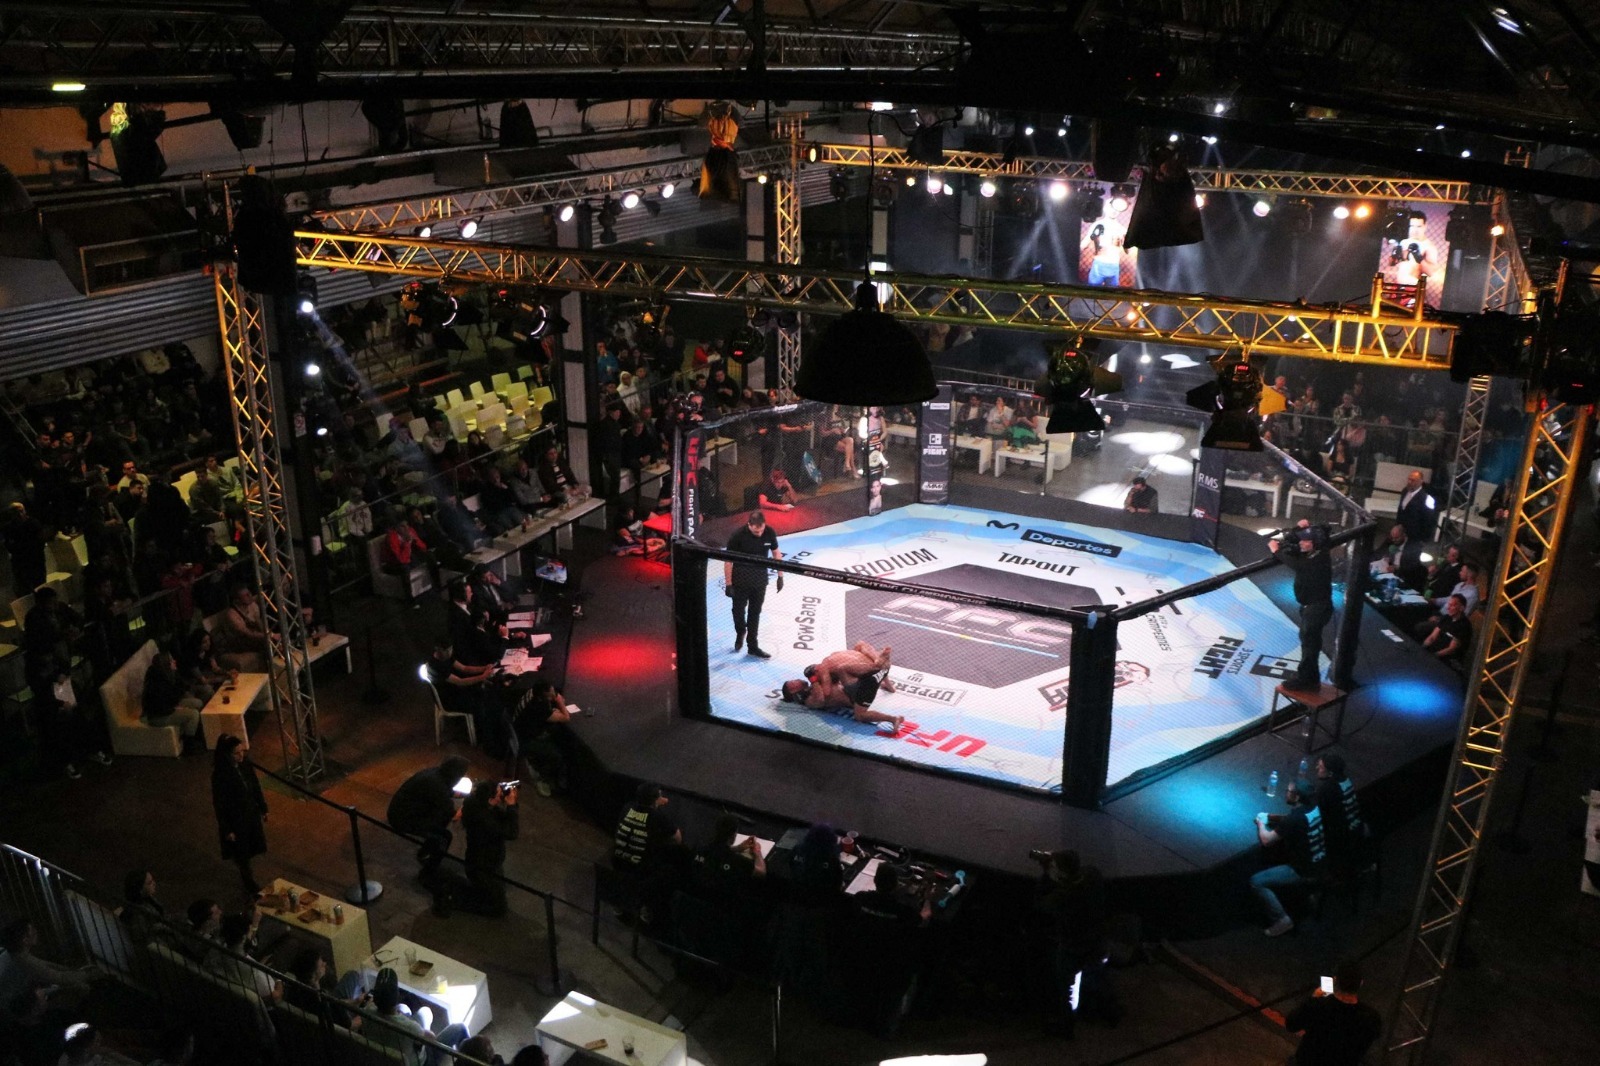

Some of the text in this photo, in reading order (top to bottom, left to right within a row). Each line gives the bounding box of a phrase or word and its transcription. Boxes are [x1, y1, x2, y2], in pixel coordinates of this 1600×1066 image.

[686, 436, 699, 486] UFC
[688, 488, 696, 516] FIGHT
[1028, 532, 1112, 555] Deportes
[997, 552, 1080, 576] TAPOUT
[793, 596, 821, 651] PowSang
[1194, 635, 1245, 680] FIGHT
[874, 721, 988, 758] UFC
